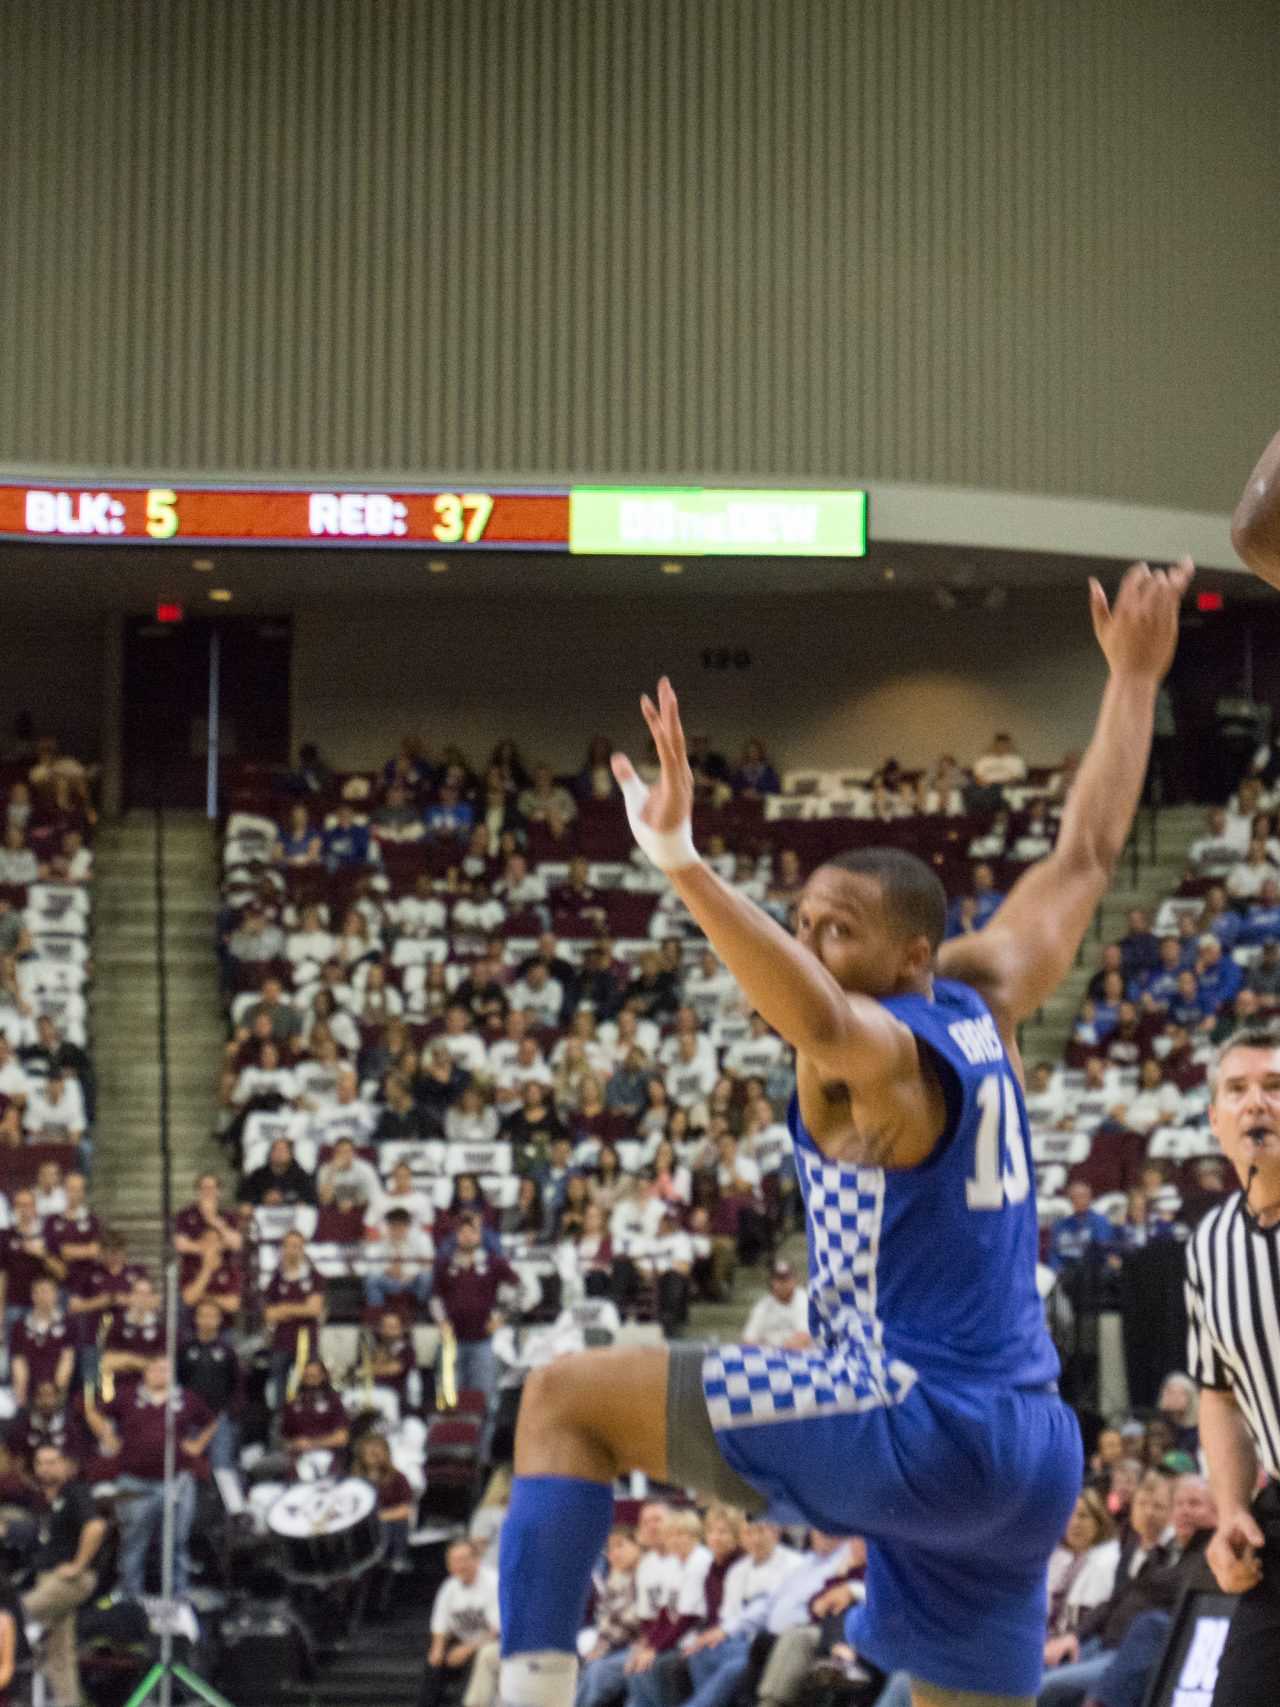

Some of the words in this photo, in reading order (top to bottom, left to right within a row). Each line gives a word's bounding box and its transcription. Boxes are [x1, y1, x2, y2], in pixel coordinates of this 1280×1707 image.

[25, 490, 126, 535] BLK:
[146, 488, 180, 539] 5
[309, 493, 408, 536] REB:
[433, 493, 495, 544] 37
